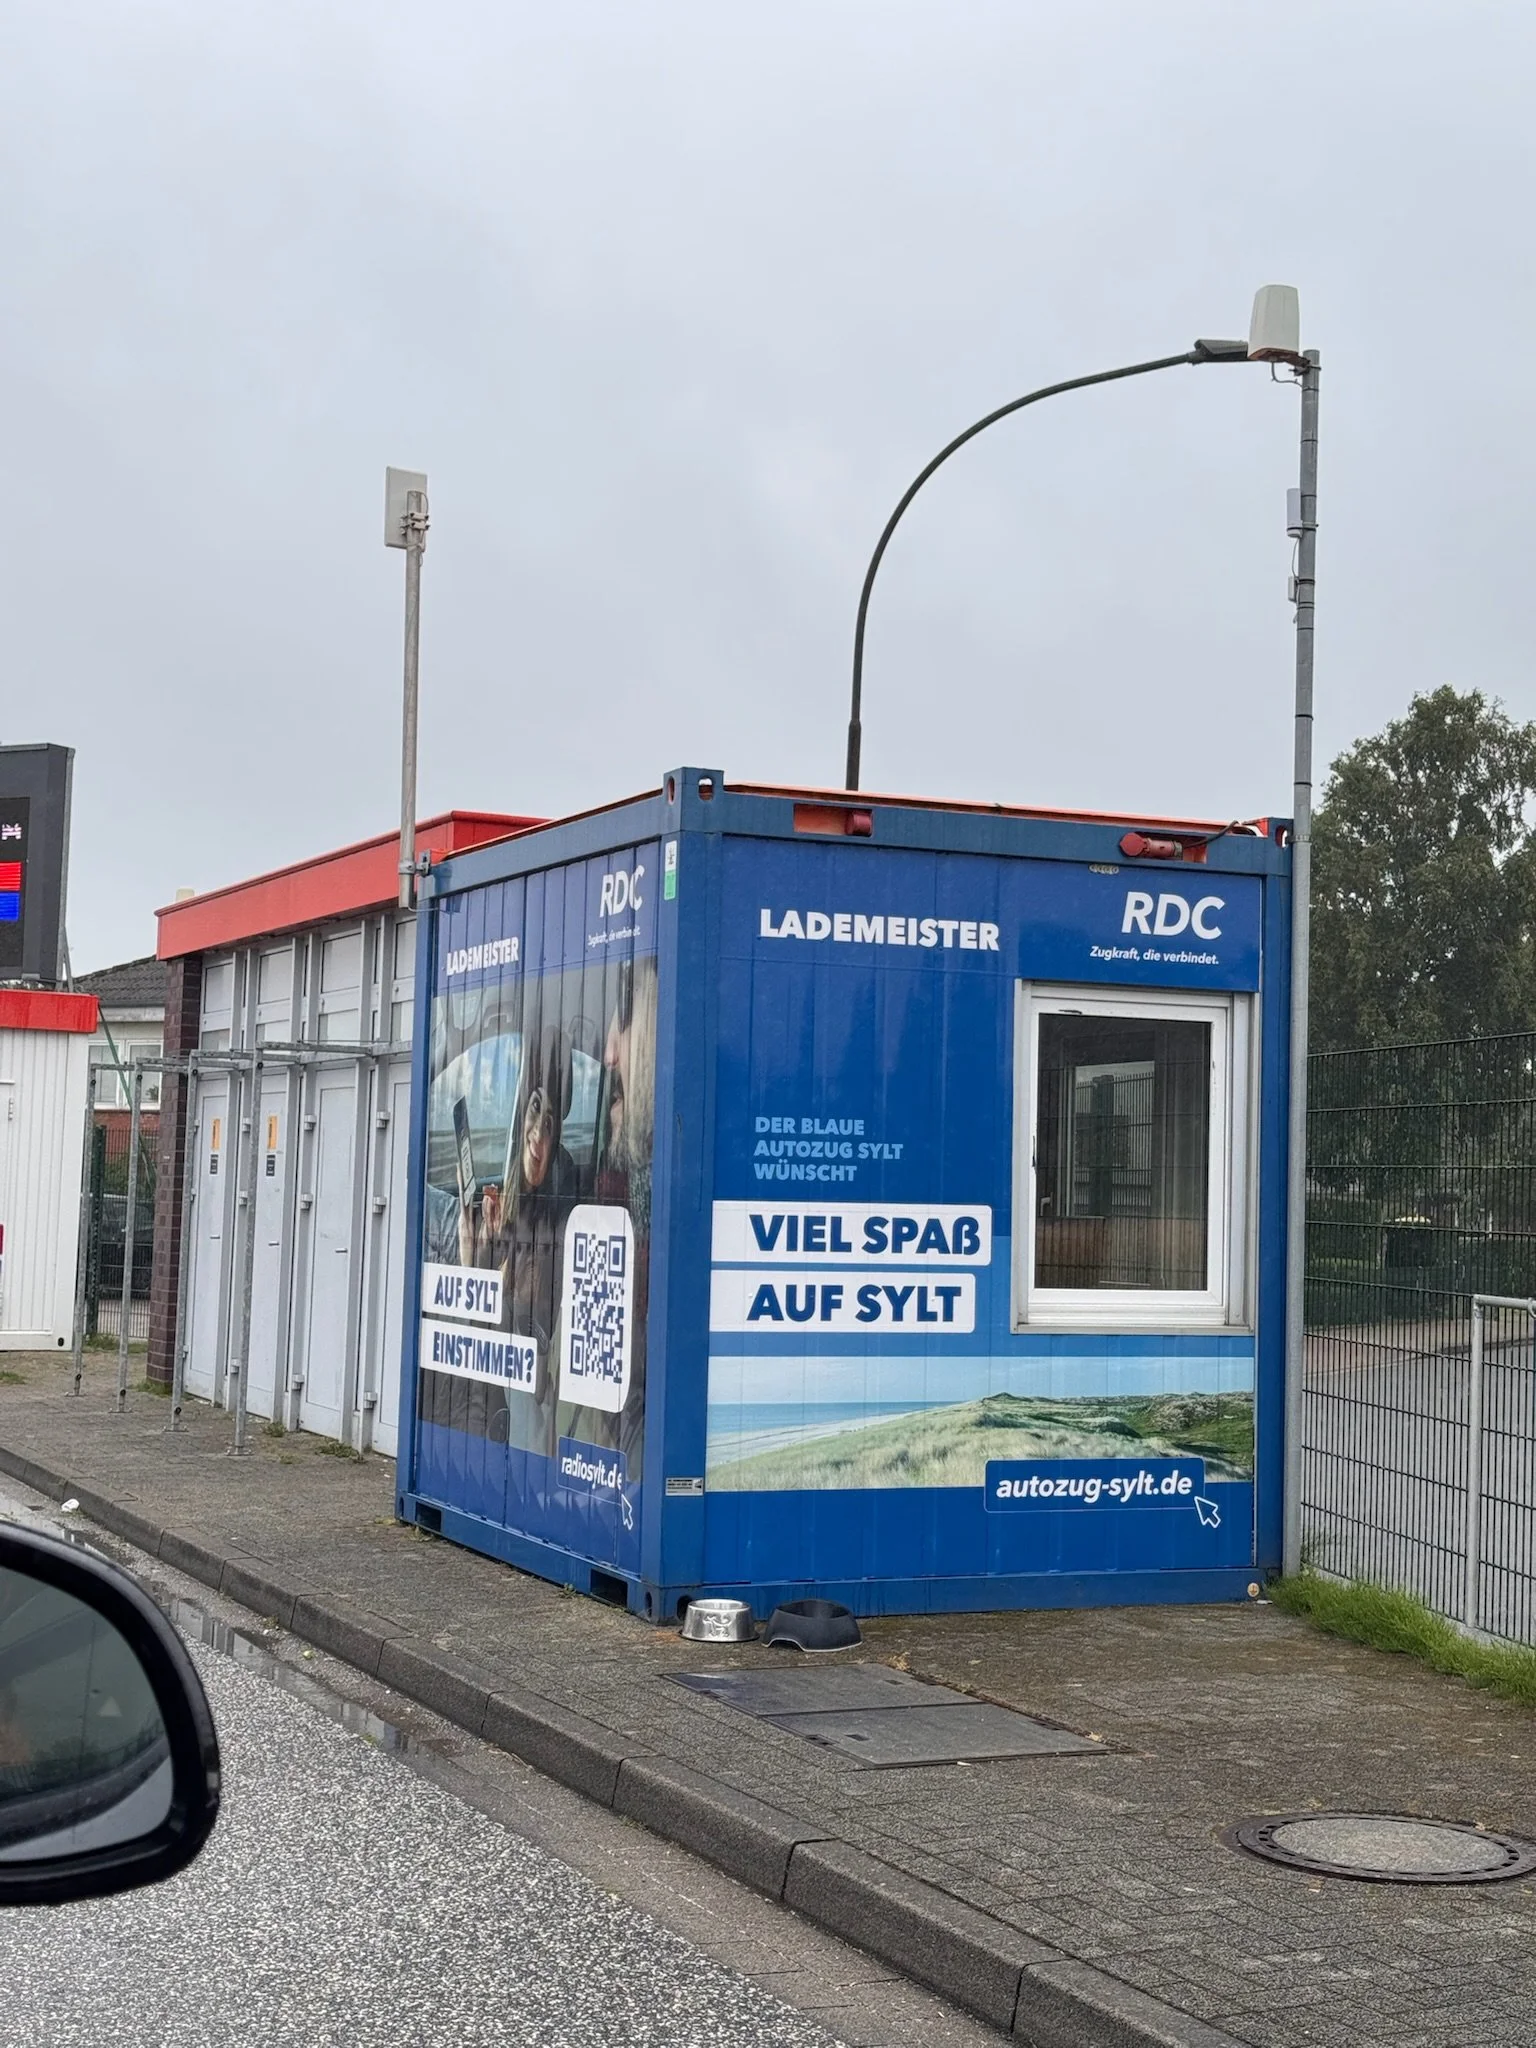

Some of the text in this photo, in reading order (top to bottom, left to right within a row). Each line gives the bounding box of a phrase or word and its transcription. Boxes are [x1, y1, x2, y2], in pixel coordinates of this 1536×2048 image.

[600, 865, 645, 918] RDC
[760, 908, 1000, 951] LADEMEISTER
[1121, 891, 1226, 940] RDC
[446, 936, 519, 976] LADEMEISTER
[1090, 946, 1219, 965] Zugkraft, die verbindet.
[755, 1117, 865, 1136] DER BLAUE
[754, 1140, 903, 1160] AUTOZUG SYLT
[754, 1159, 857, 1182] WÜNSCHT
[749, 1214, 852, 1253] VIEL
[434, 1275, 499, 1314] AUF SYLT
[746, 1284, 962, 1323] AUF SYLT
[433, 1331, 535, 1384] EINSTIMMEN?
[561, 1453, 622, 1490] radiosylt.de
[996, 1470, 1193, 1503] autozug-sylt.de
